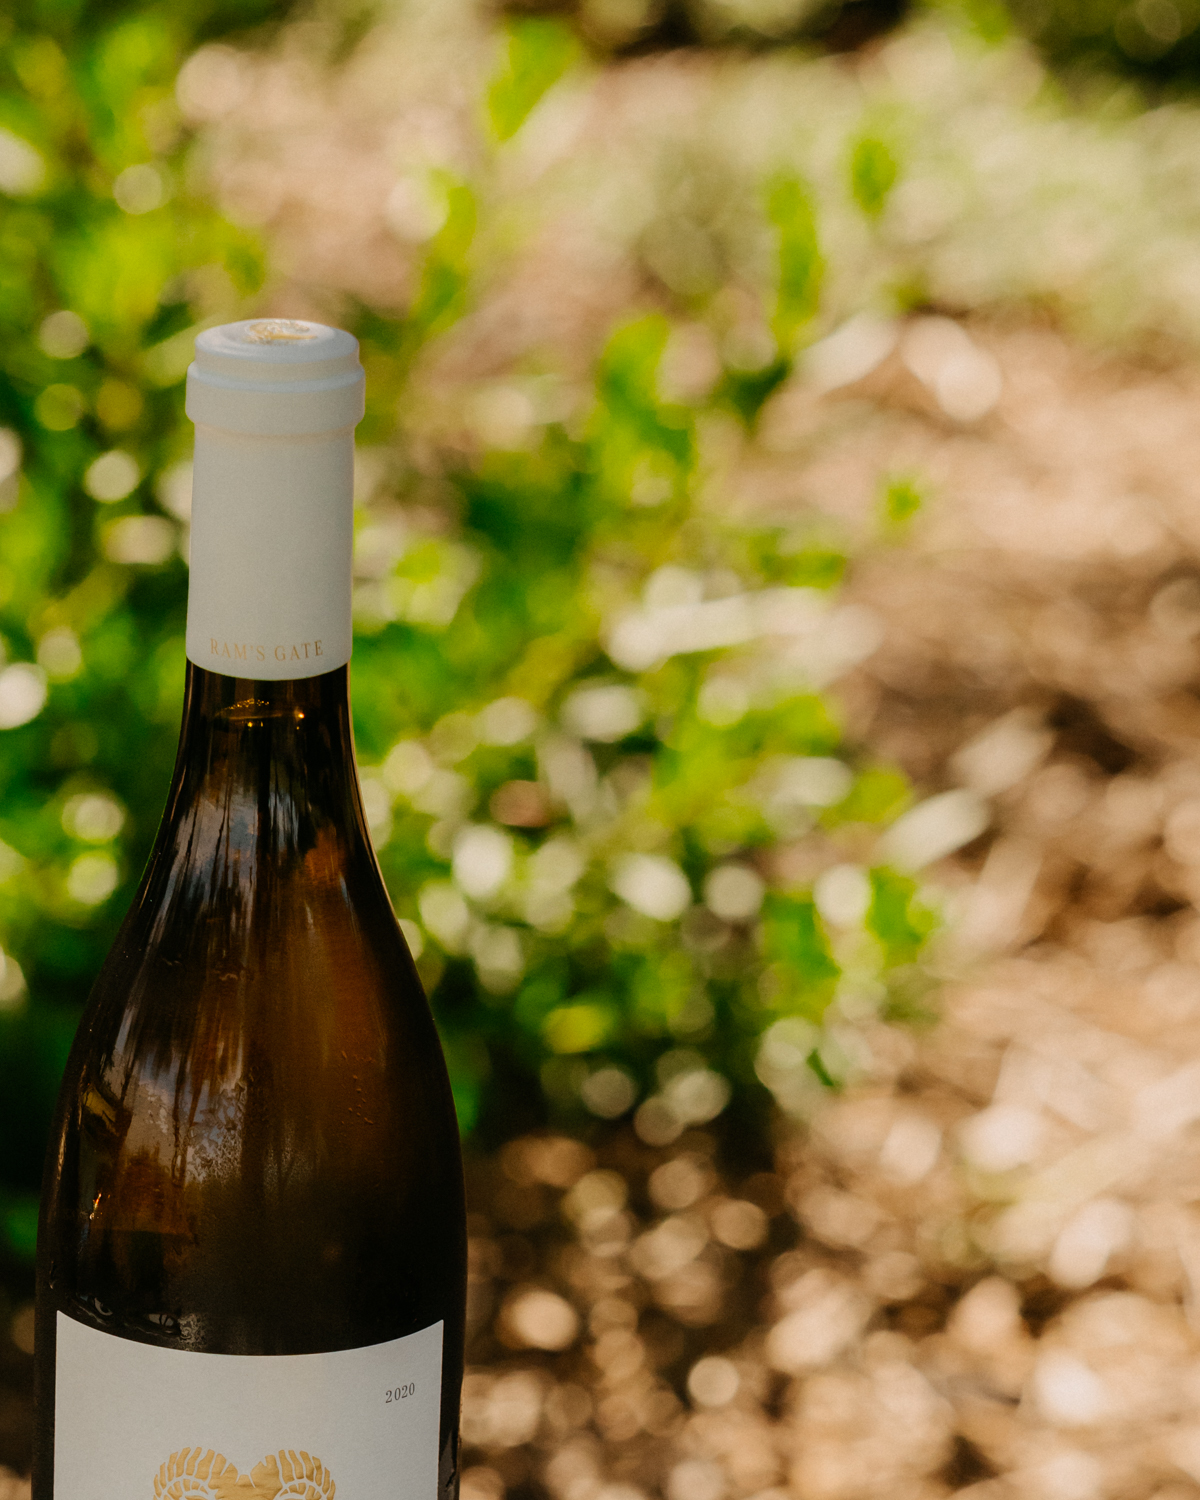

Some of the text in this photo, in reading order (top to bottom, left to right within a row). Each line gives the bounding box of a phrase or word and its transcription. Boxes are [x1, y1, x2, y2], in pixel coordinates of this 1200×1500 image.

[209, 637, 324, 662] RAM'S GATE
[385, 1382, 415, 1404] 2020
